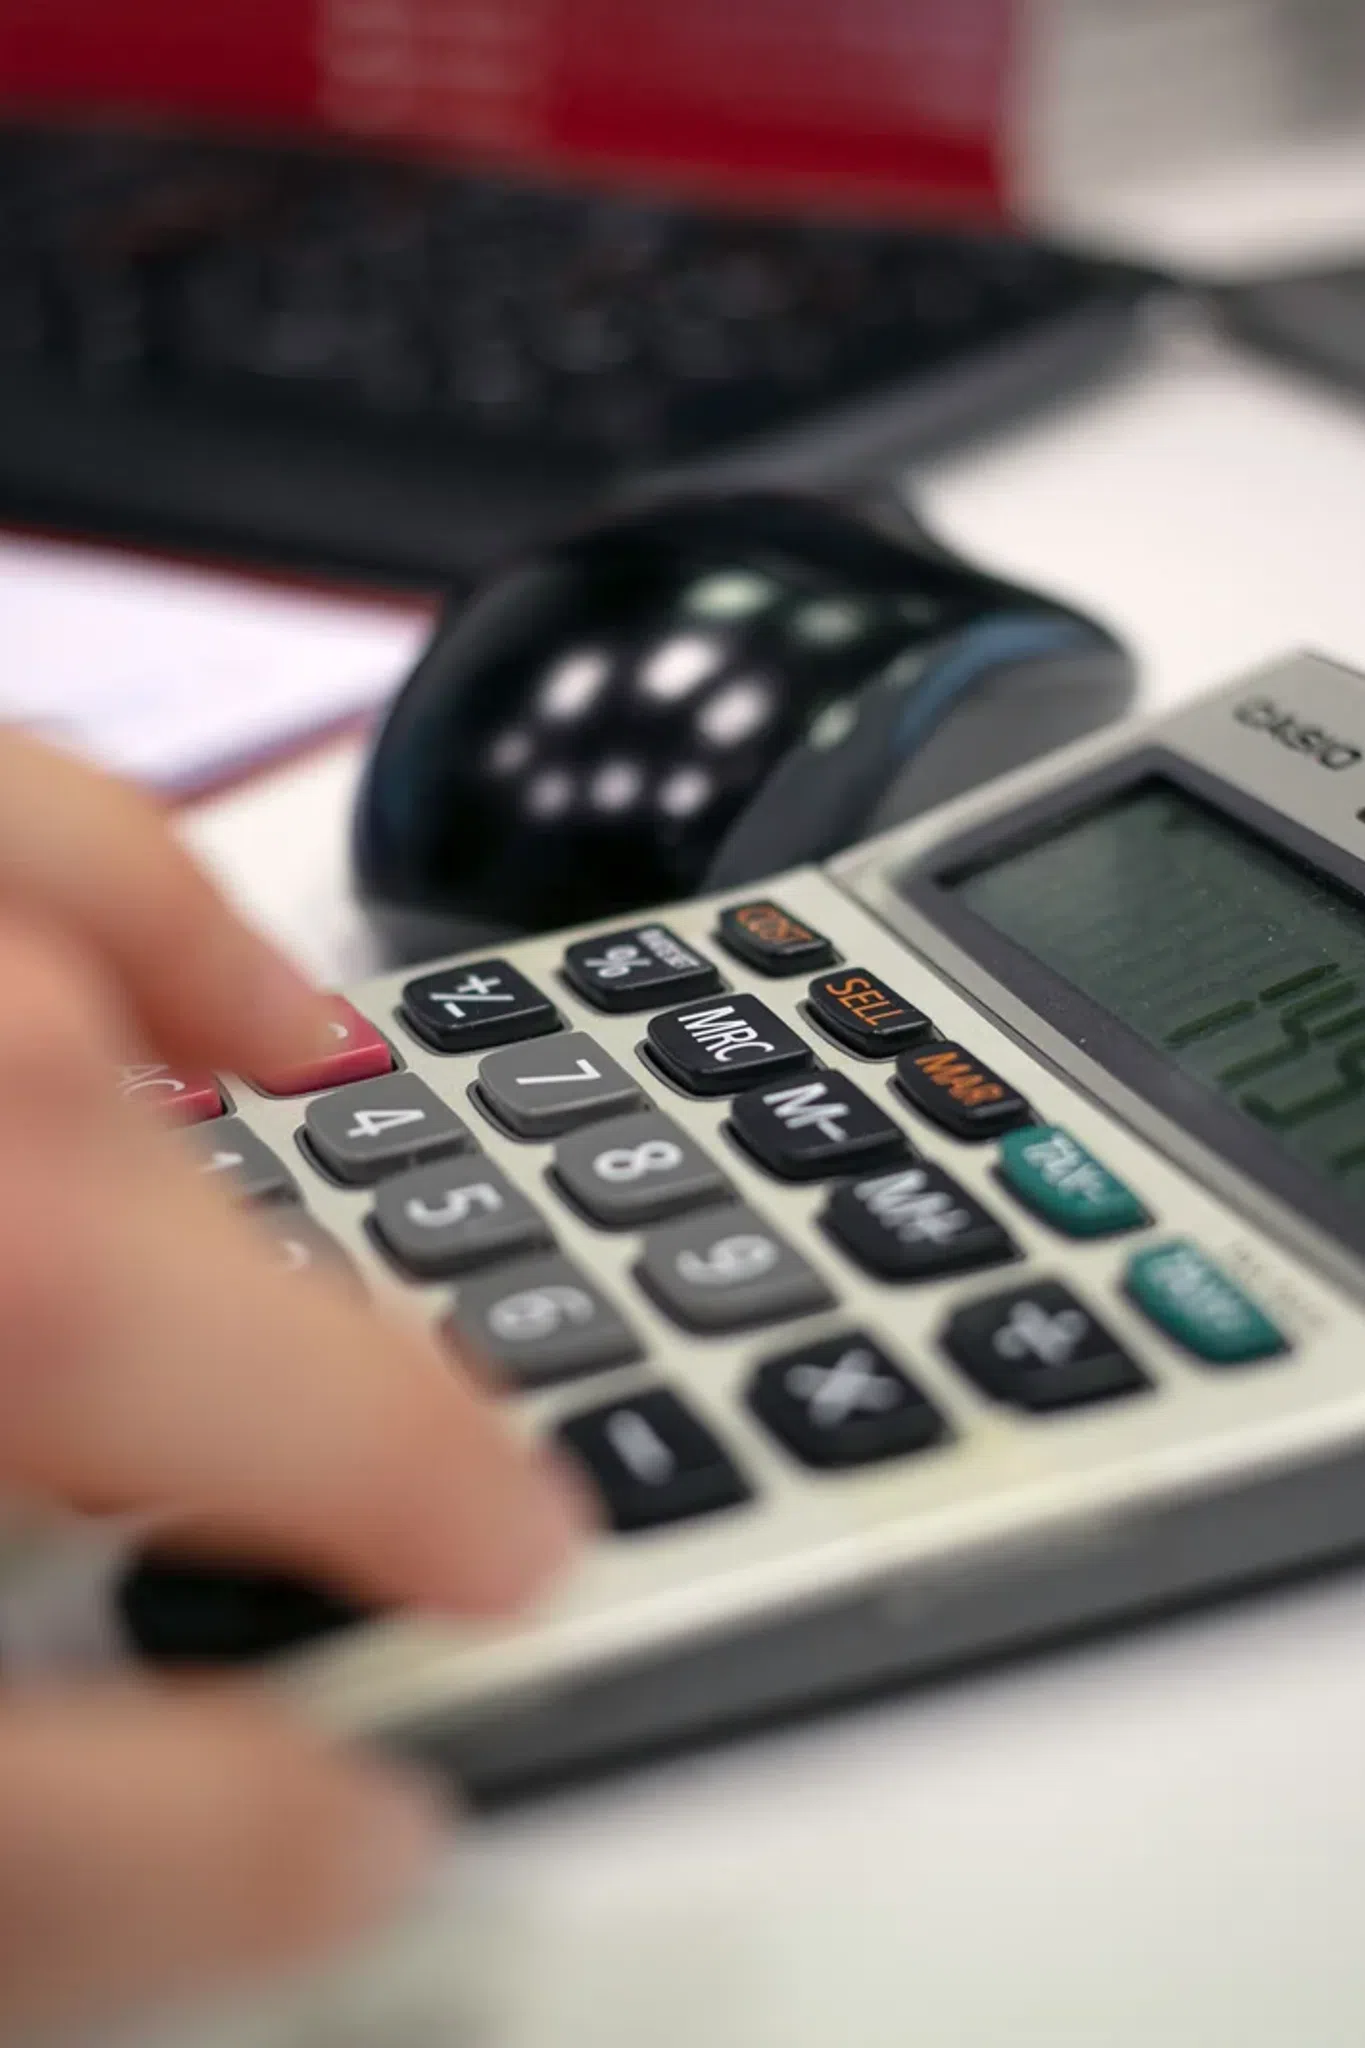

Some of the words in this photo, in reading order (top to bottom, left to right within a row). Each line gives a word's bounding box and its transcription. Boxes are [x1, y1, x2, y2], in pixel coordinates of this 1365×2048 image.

[584, 944, 652, 978] %
[826, 977, 905, 1026] SELL
[678, 1005, 775, 1063] MRC
[515, 1059, 602, 1086] 7
[347, 1109, 427, 1138] 4
[762, 1082, 849, 1142] M-
[593, 1140, 683, 1182] 8
[406, 1182, 502, 1228] 5
[676, 1233, 778, 1286] 9
[487, 1284, 596, 1342] 6
